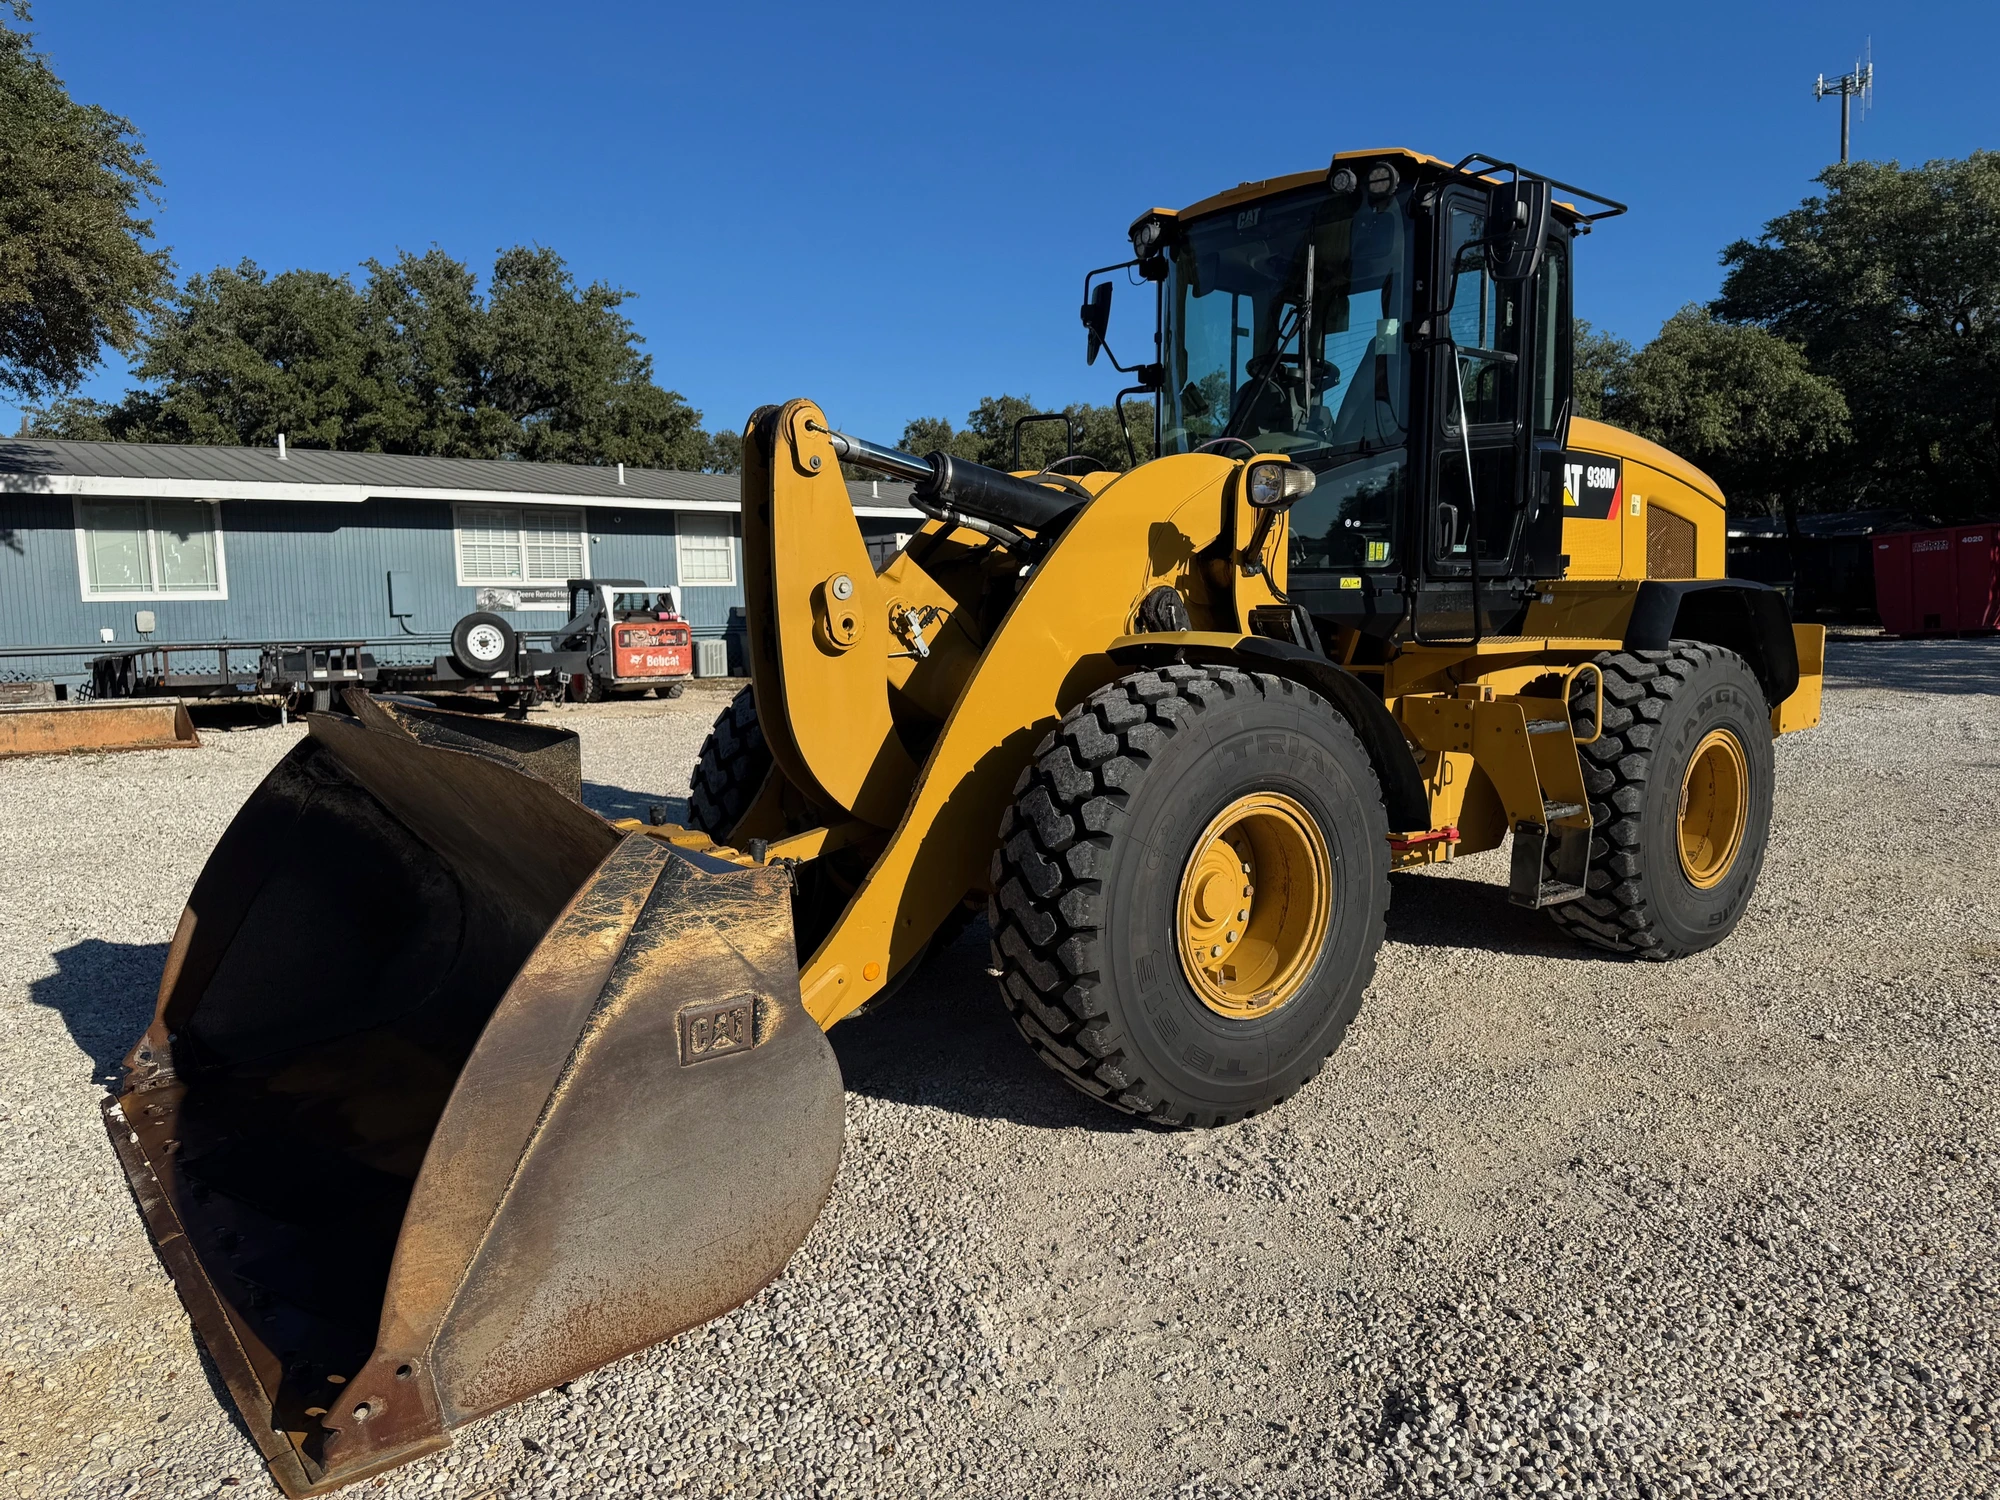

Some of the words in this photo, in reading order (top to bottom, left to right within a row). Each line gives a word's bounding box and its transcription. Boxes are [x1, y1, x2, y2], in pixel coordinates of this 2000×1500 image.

[1237, 207, 1261, 230] CAT
[1564, 463, 1583, 507] AT
[1586, 465, 1616, 489] 938M
[1961, 535, 1984, 543] 4020
[516, 590, 535, 599] Deere
[535, 590, 556, 598] Rented
[646, 654, 680, 667] Bobcat
[690, 1007, 748, 1056] CAT
